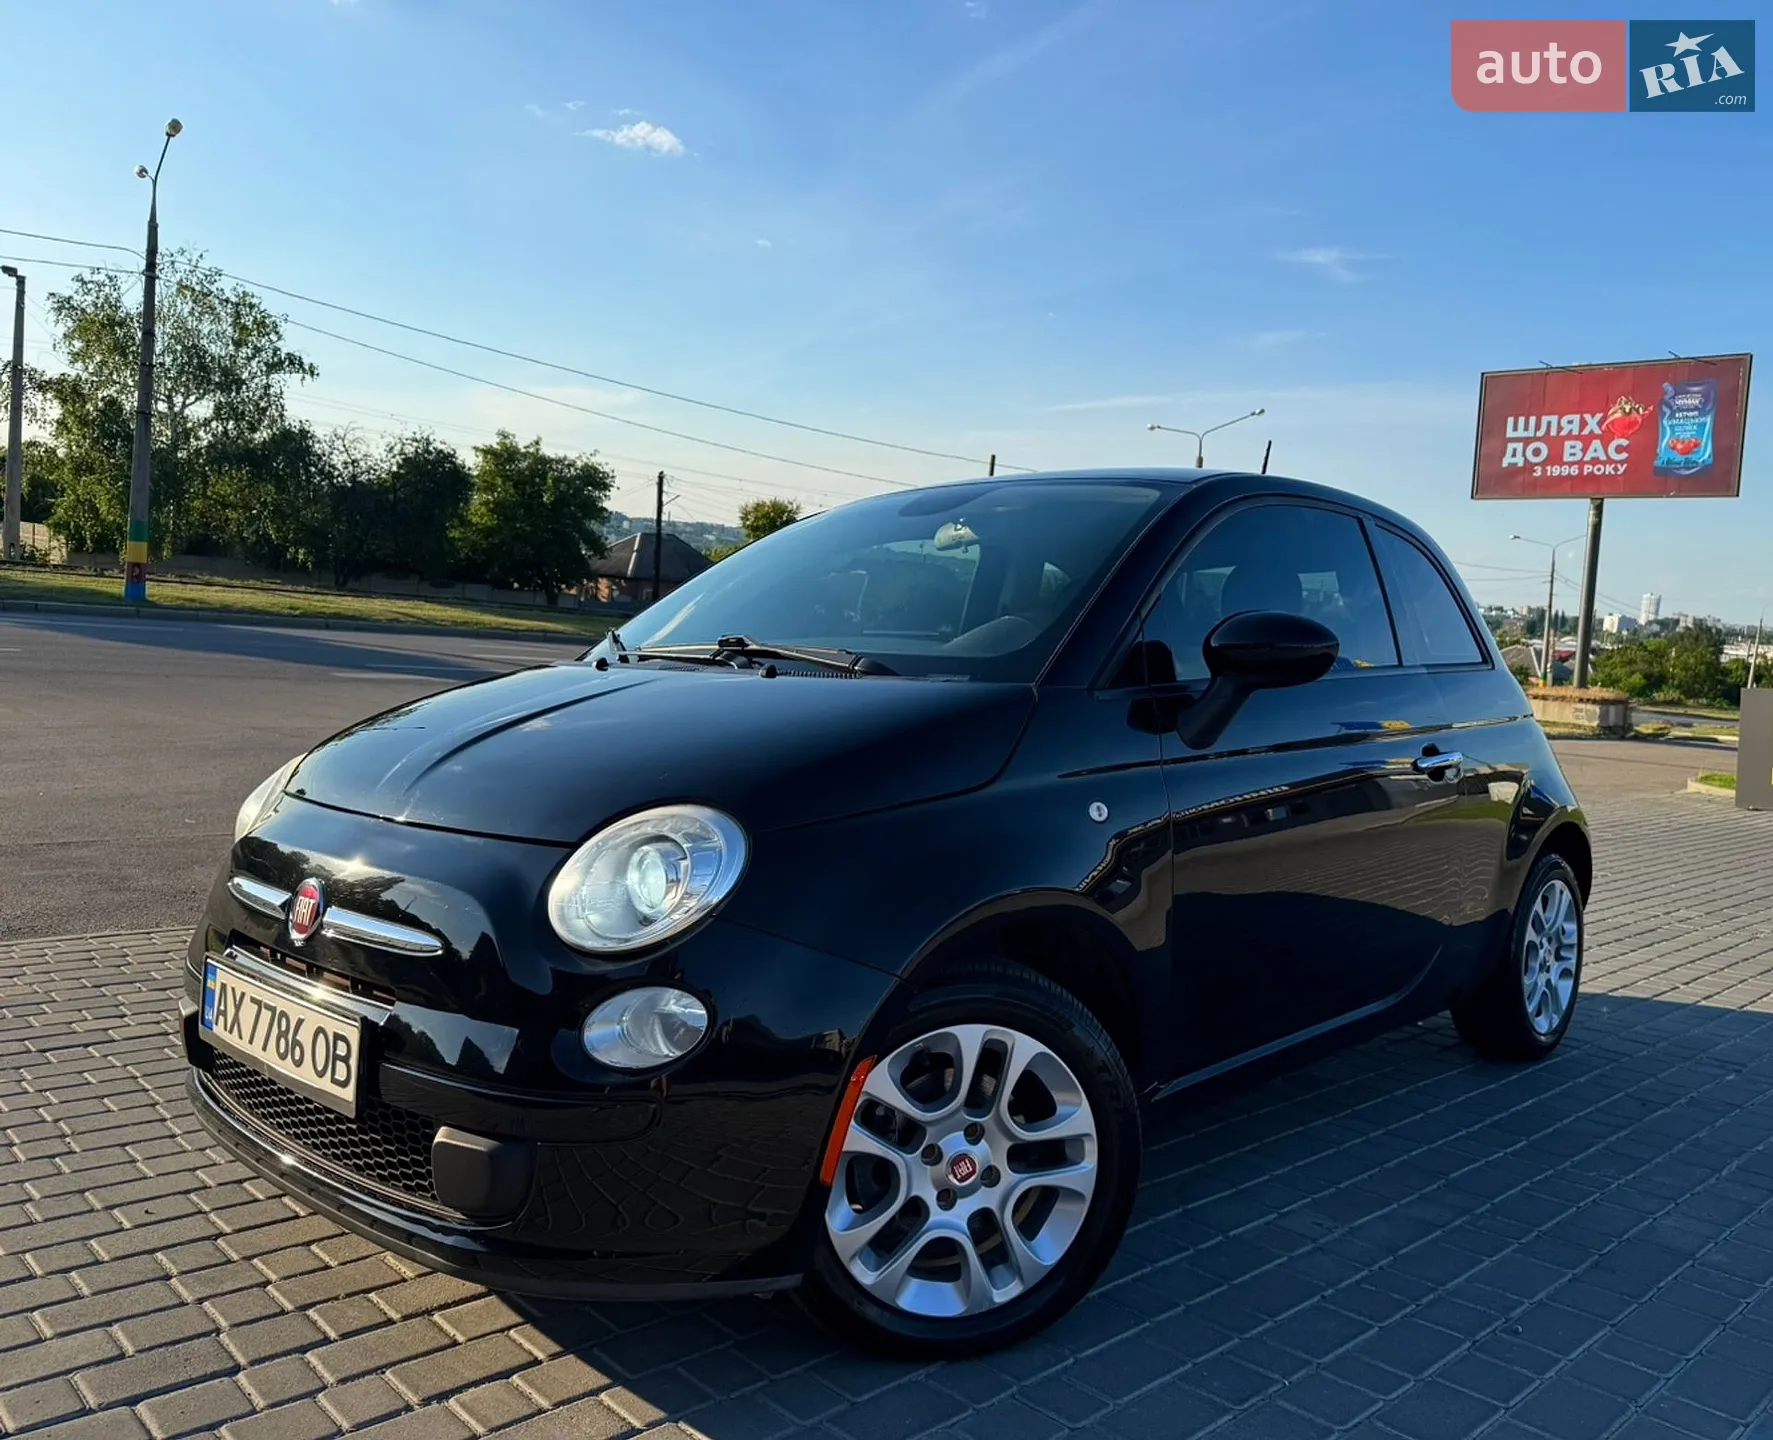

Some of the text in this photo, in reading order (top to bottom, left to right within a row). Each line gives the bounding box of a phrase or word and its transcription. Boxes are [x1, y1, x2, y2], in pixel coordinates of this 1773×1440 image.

[1505, 412, 1604, 438] ШЛЯХ
[1501, 438, 1629, 468] ДО ВАС
[1545, 464, 1579, 477] 1996
[1583, 463, 1628, 476] РОКУ
[295, 895, 317, 927] FIAT
[215, 982, 353, 1089] AX 7786 OB
[953, 1158, 973, 1180] FIAT
